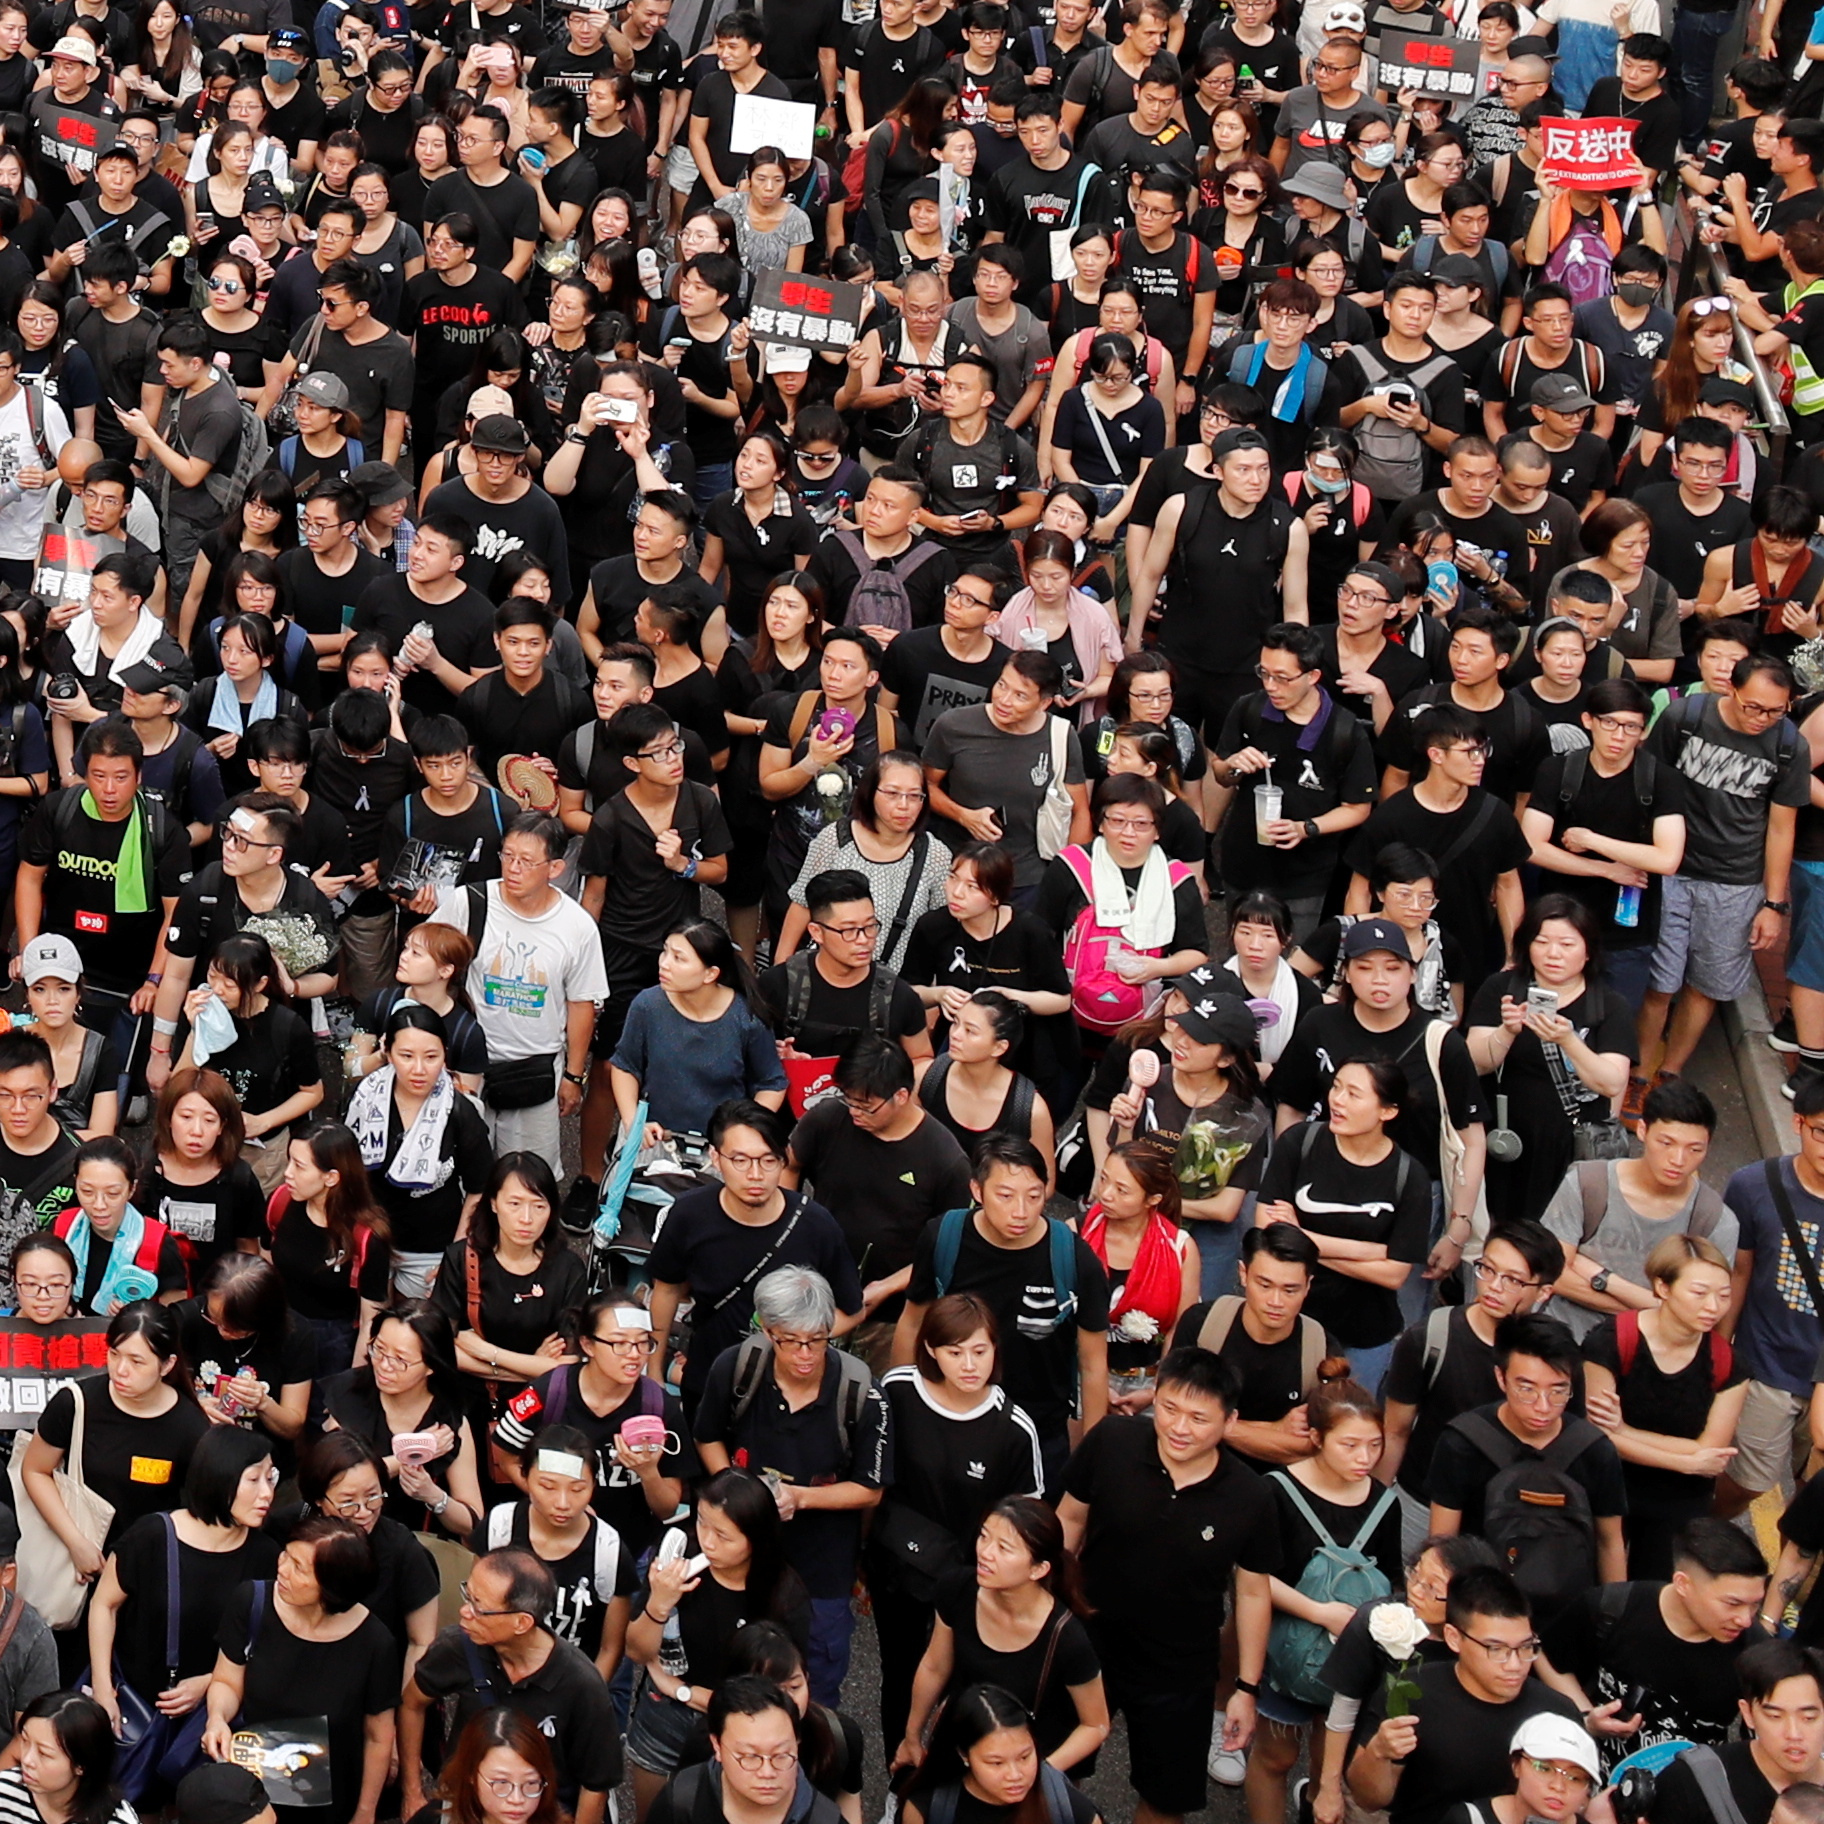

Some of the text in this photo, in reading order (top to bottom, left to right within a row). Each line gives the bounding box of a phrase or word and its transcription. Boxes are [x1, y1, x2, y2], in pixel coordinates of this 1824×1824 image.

[1404, 41, 1454, 68] 學生
[1379, 63, 1475, 95] 沒有暴動
[56, 117, 99, 147] 學生
[1546, 126, 1631, 164] 反送中
[40, 134, 96, 172] 沒有暴
[1559, 171, 1600, 181] EXTRADITION
[780, 281, 833, 314] 學生
[423, 306, 470, 325] LE COQ
[750, 305, 856, 346] 沒有暴動
[493, 987, 538, 1001] MARATHON
